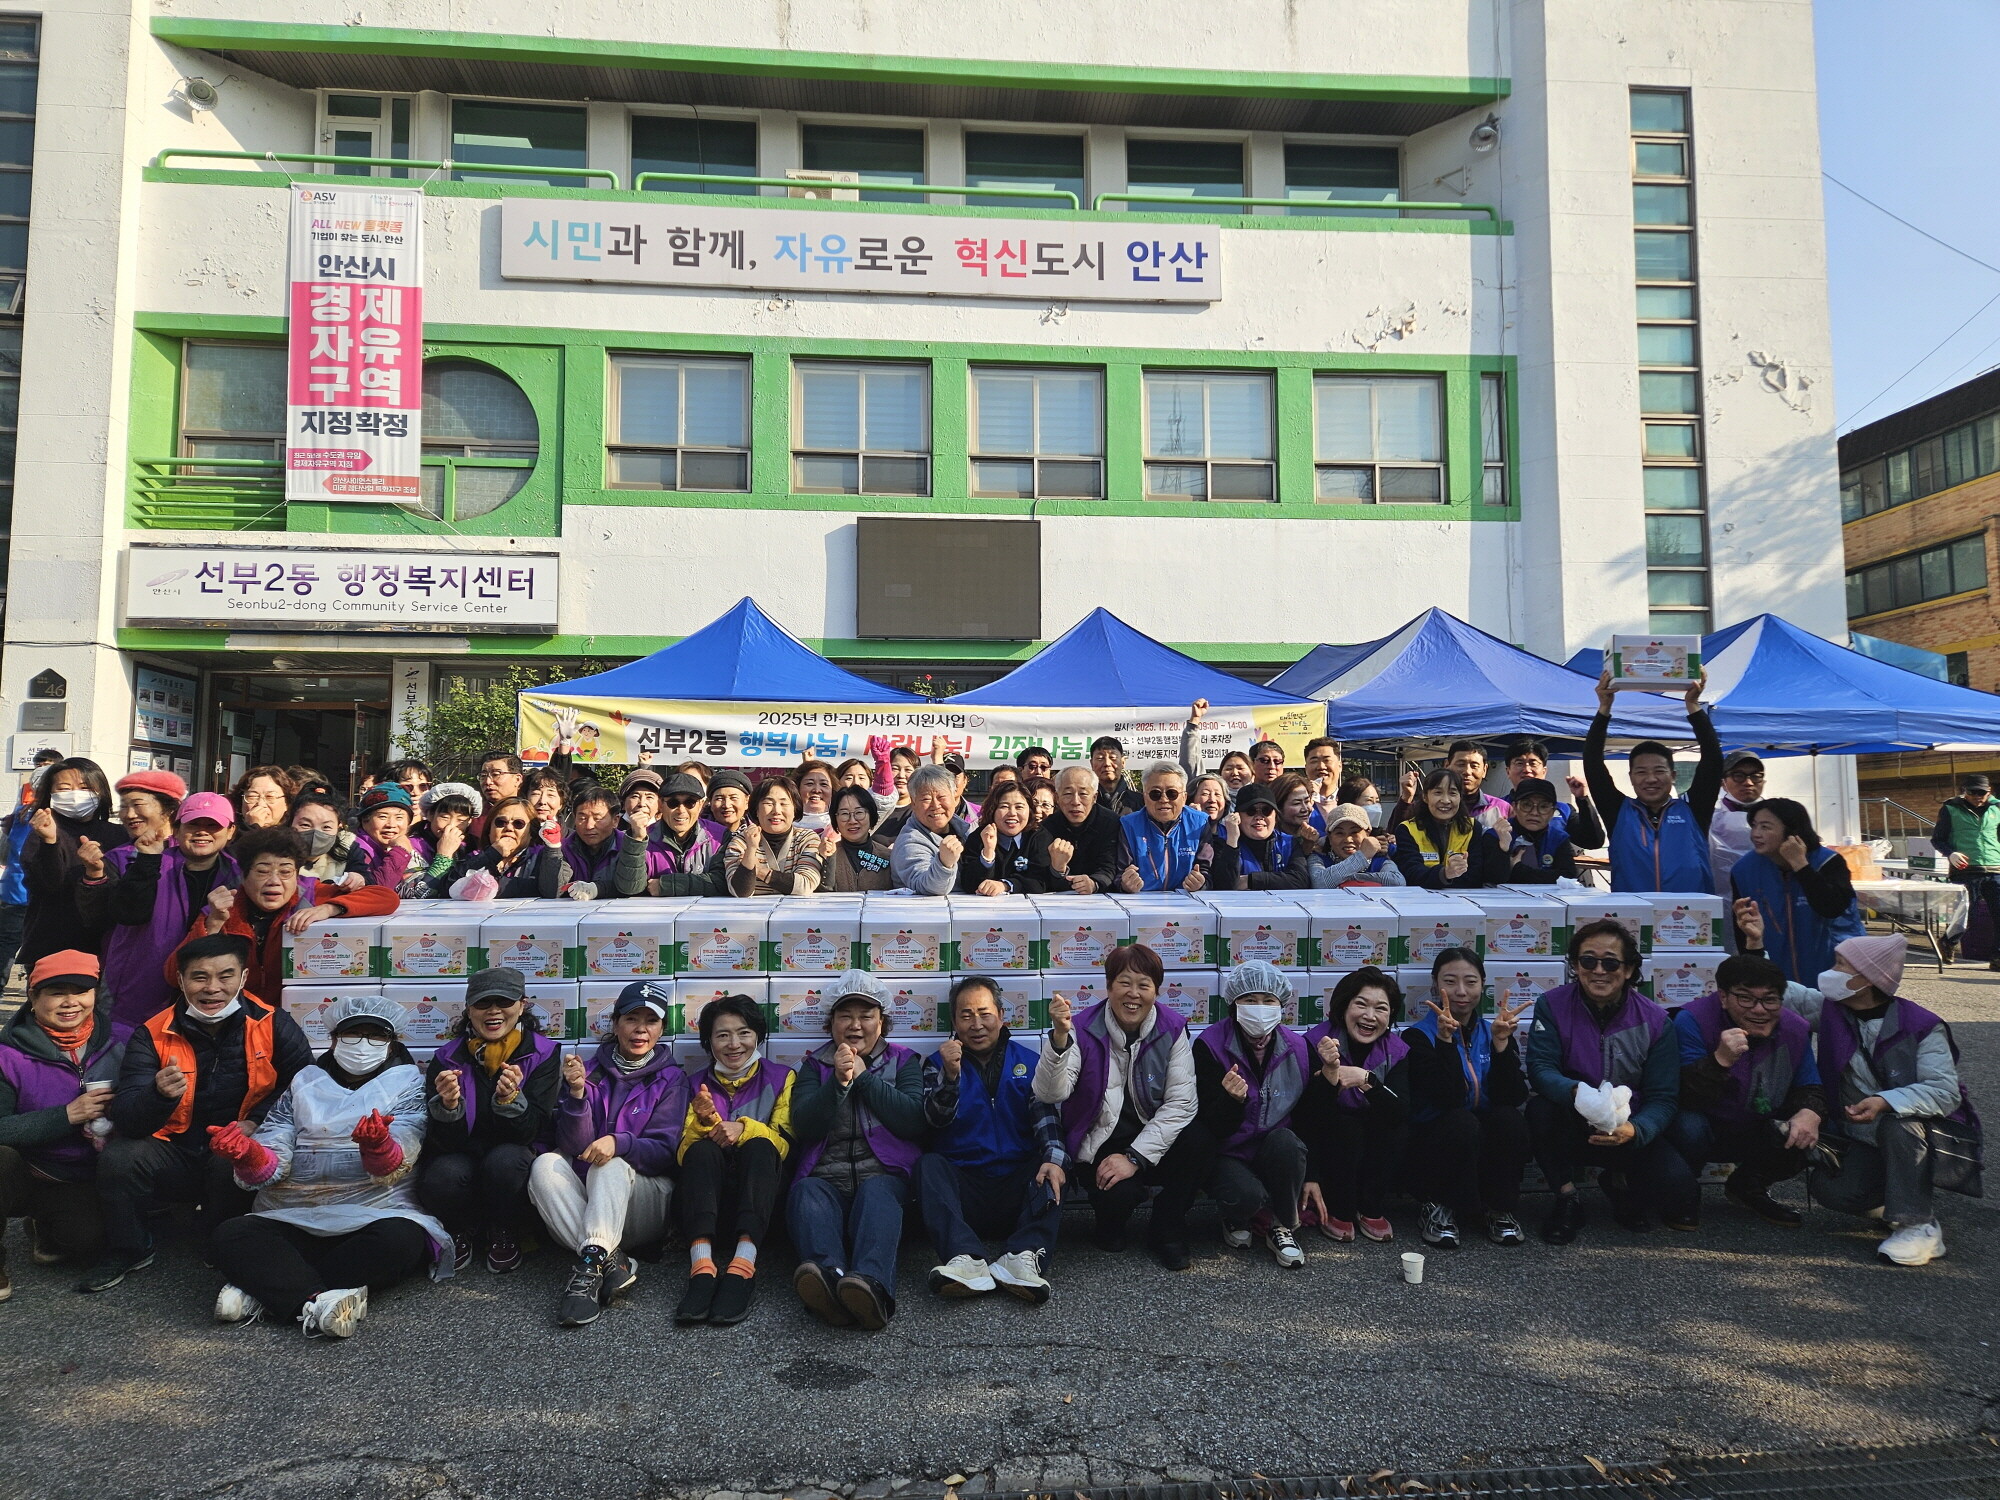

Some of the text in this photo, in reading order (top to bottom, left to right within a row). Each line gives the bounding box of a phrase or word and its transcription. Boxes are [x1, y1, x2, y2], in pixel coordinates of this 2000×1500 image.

[313, 192, 336, 201] ASV
[311, 219, 404, 233] ALL NEW 플랫폼
[311, 232, 404, 245] 기업이 찾는 도시, 안산
[523, 219, 1208, 283] 시민과 함께, 자유로운 혁신도시 안산
[318, 254, 396, 281] 안산시
[322, 451, 345, 459] 수도권
[346, 452, 361, 460] 유일
[339, 460, 353, 468] 지정
[194, 561, 535, 600] 선부2동 행정복지센터
[152, 588, 181, 596] 안산시
[227, 598, 508, 614] Seonbu2-dong Community Service Center
[45, 684, 65, 697] 46
[758, 711, 966, 729] 2025년 한국마사회 지원사업
[1114, 723, 1129, 731] 일시
[1136, 722, 1156, 732] 2025.
[1159, 723, 1167, 731] 11.
[1169, 722, 1181, 731] 20.
[1227, 721, 1248, 729] 14:00
[637, 727, 727, 756] 선부2동
[739, 730, 849, 758] 행복나눔!
[1210, 734, 1232, 744] 주차장
